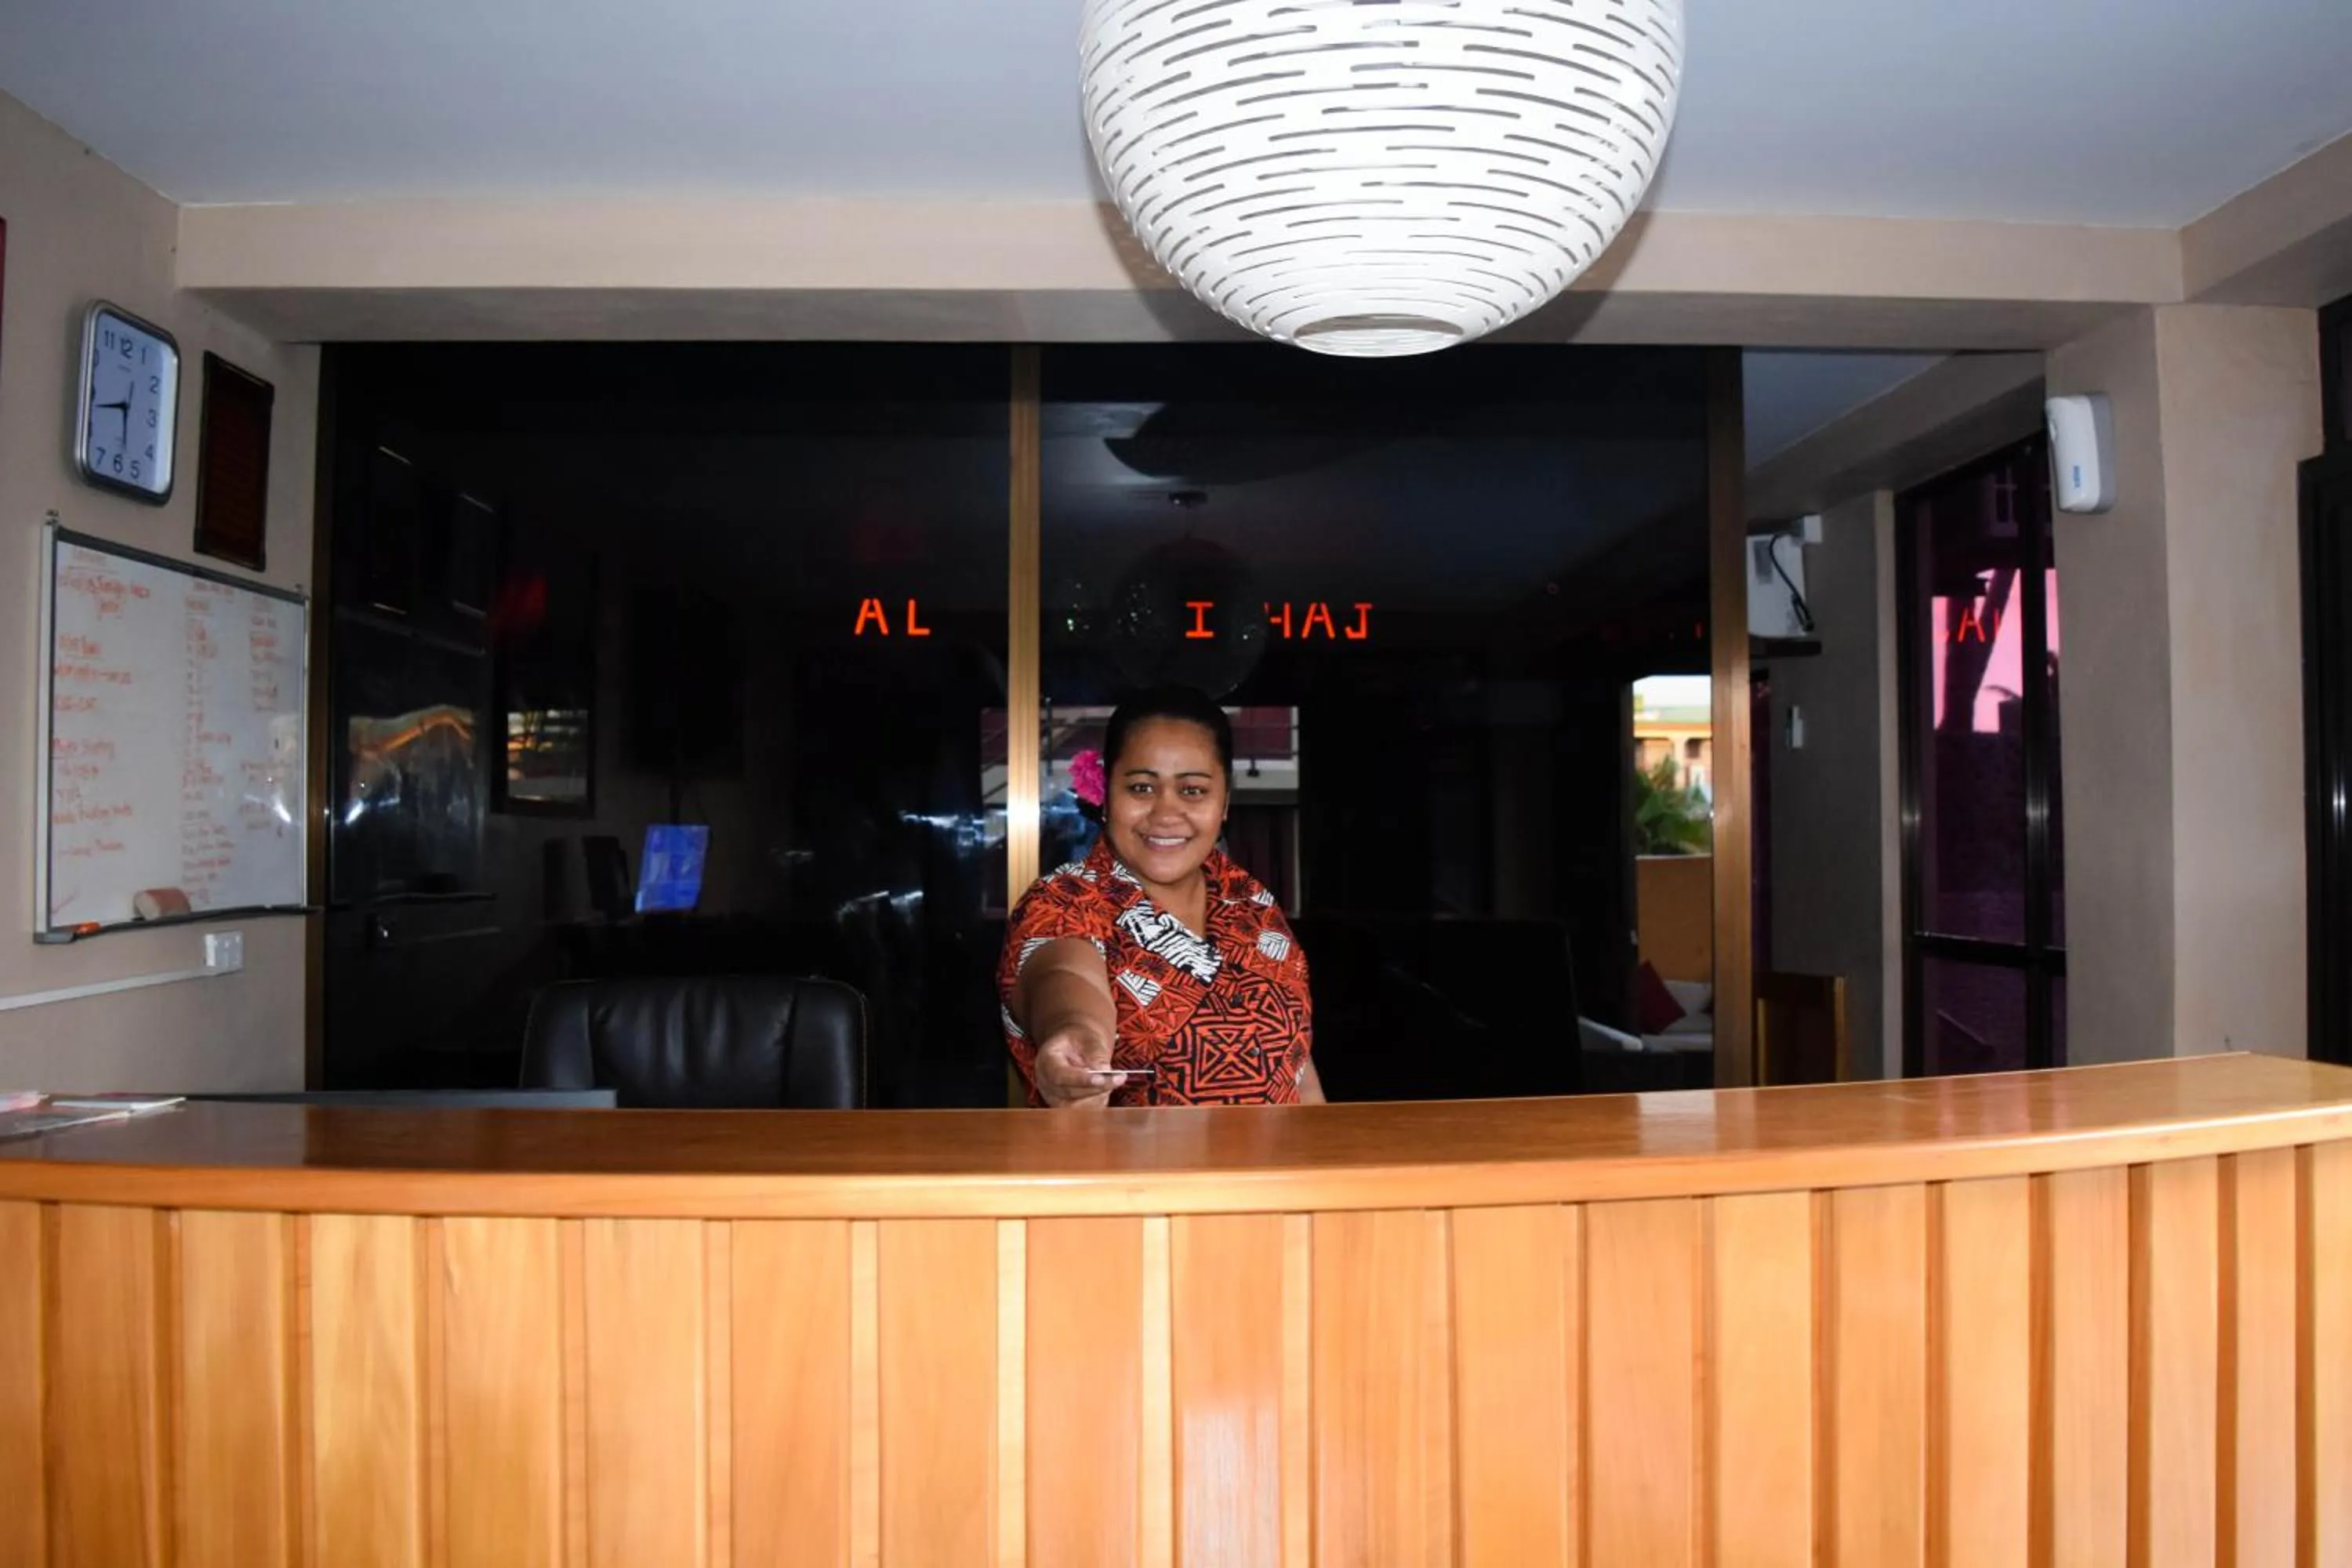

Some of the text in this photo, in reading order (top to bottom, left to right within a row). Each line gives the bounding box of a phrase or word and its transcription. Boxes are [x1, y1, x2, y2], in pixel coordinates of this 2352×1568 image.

[103, 330, 115, 350] 11
[120, 338, 133, 360] 12
[149, 375, 160, 394] 2
[147, 409, 158, 429] 3
[95, 446, 106, 470] 7
[112, 453, 125, 475] 6
[129, 459, 141, 481] 5
